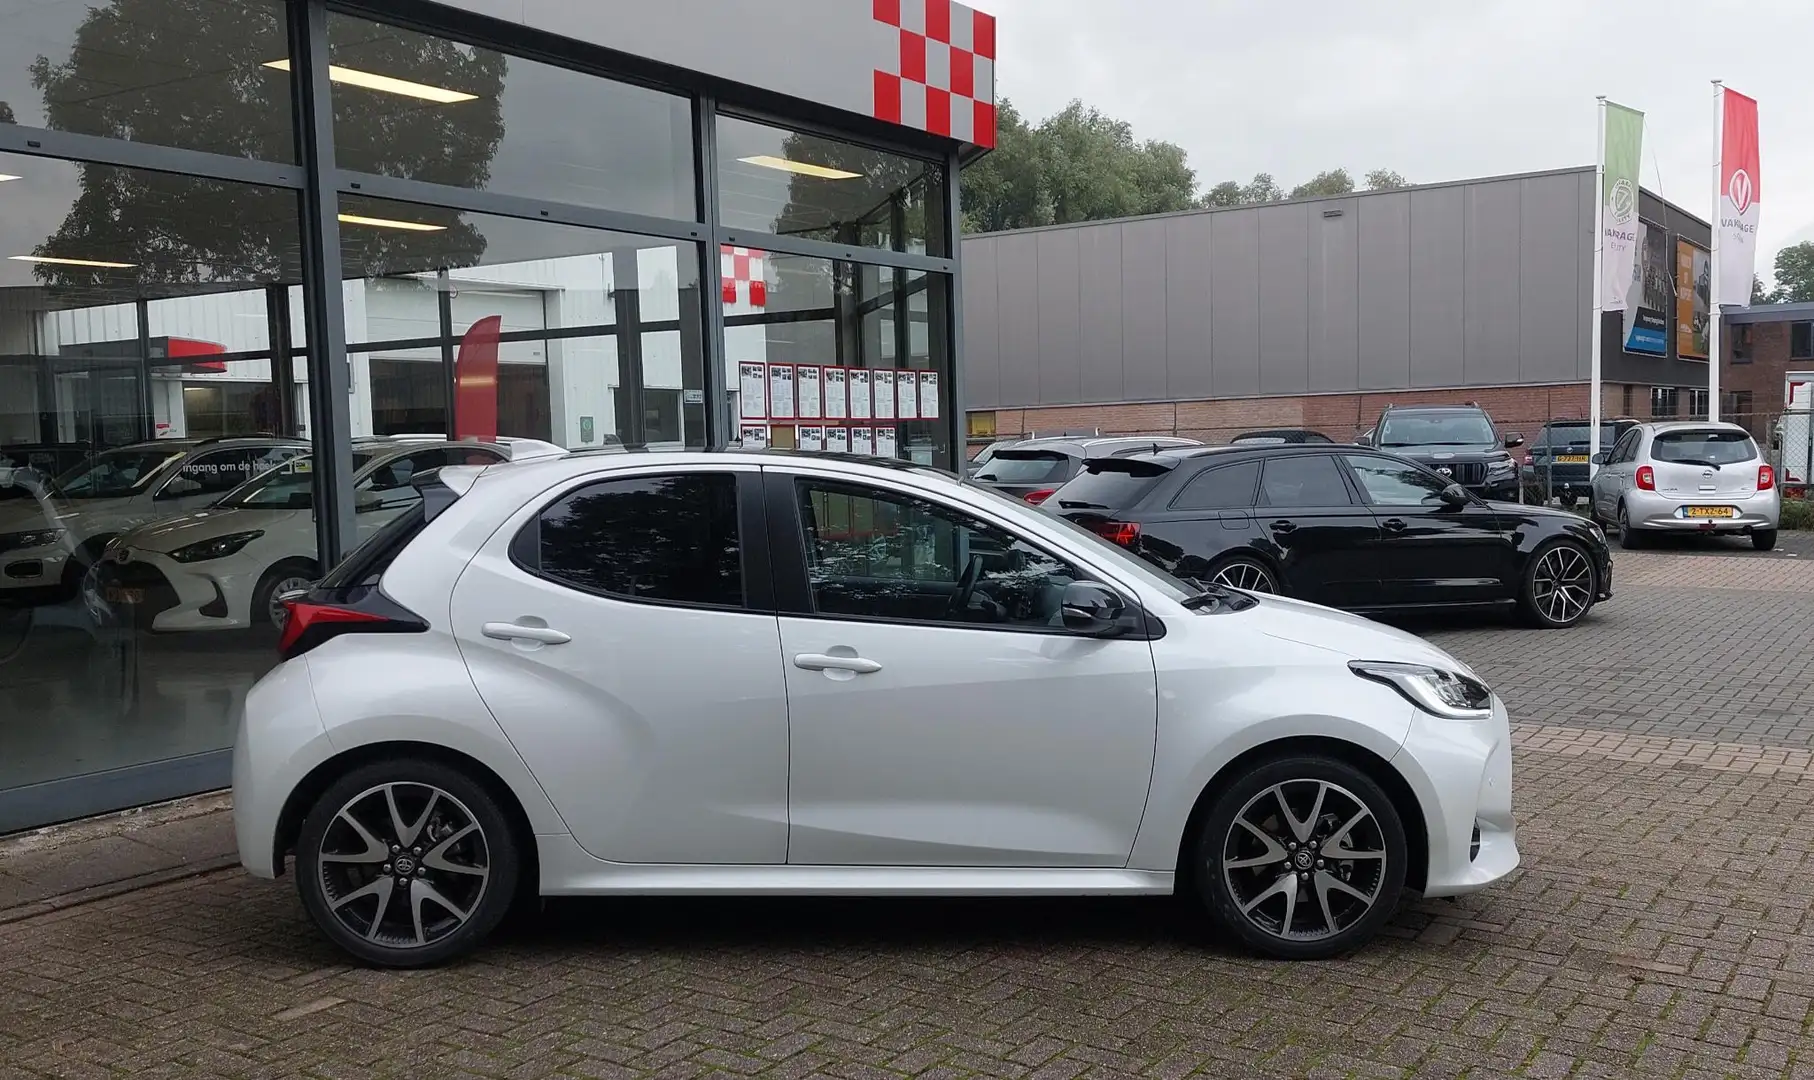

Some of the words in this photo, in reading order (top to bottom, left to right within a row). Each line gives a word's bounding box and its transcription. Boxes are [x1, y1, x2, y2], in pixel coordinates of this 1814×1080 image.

[219, 462, 236, 472] om
[238, 460, 251, 472] de
[1691, 507, 1729, 515] 2-TXZ-64
